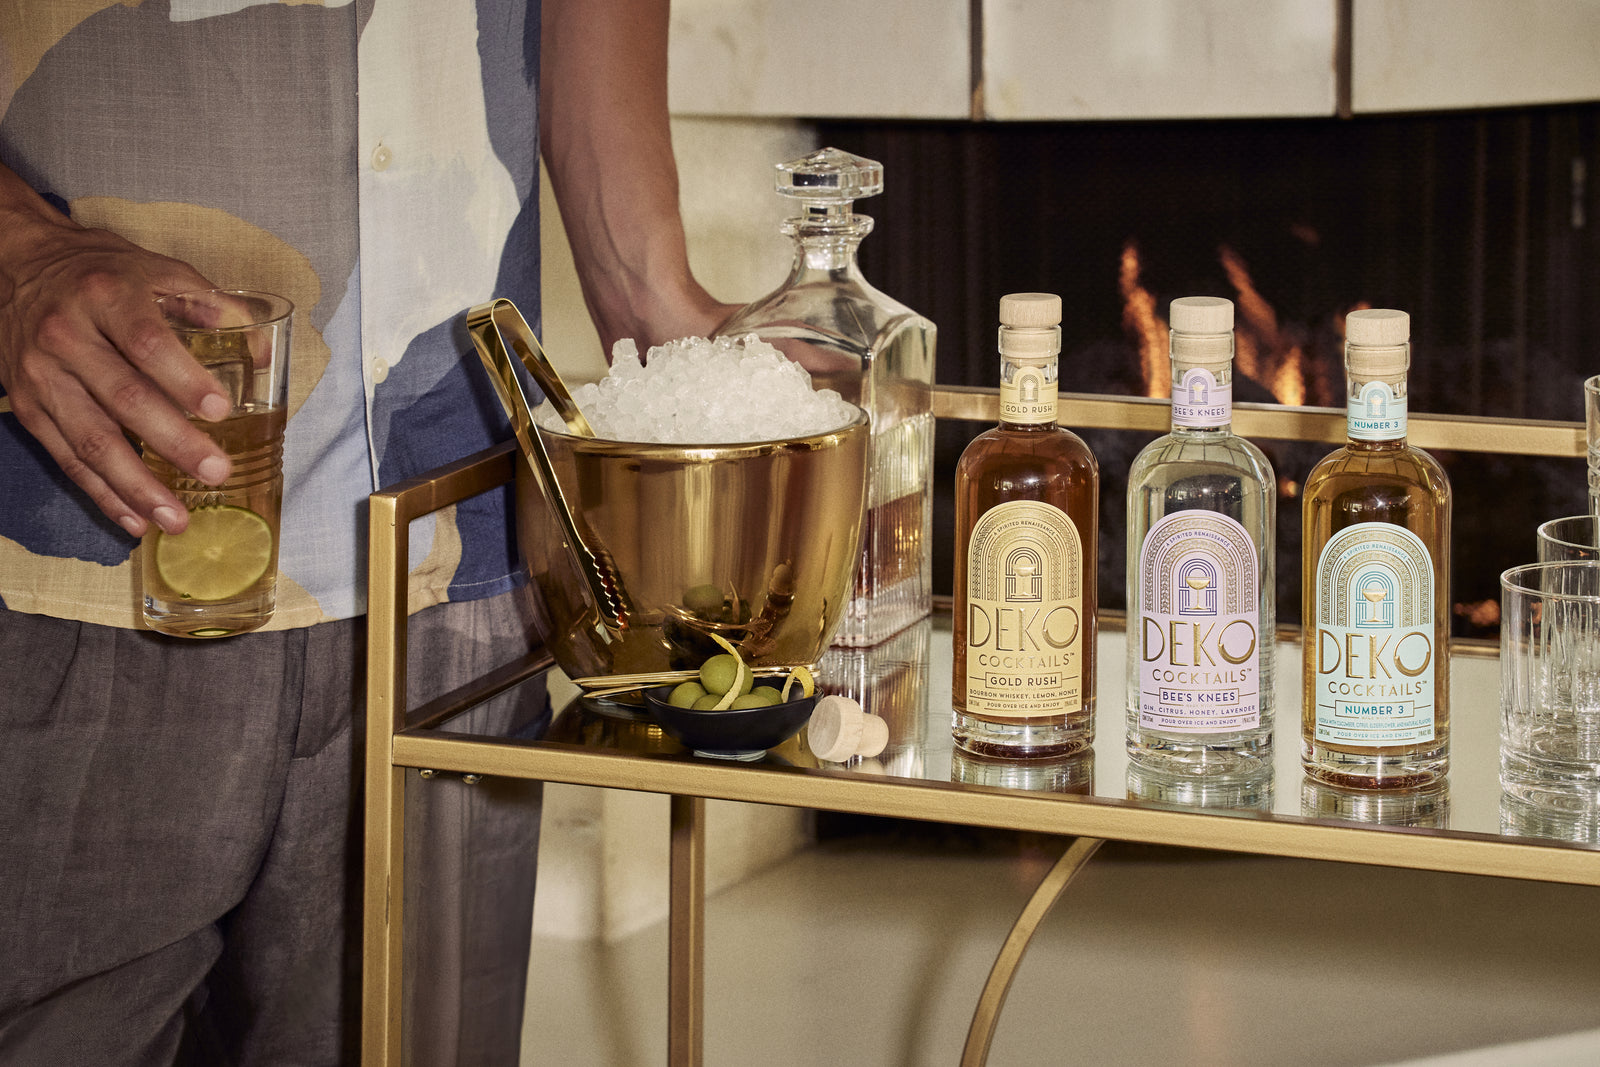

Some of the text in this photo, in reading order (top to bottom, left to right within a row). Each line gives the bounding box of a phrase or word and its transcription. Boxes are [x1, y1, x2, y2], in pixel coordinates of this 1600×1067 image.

[1005, 404, 1028, 414] GOLD
[1174, 406, 1225, 416] BEE'S KNEES
[1354, 421, 1390, 429] NUMBER
[997, 521, 1020, 532] SPIRITED
[1020, 520, 1056, 536] RENAISSANCE
[1170, 532, 1192, 544] SPIRITED
[1194, 531, 1230, 547] RENAISSANCE
[970, 603, 1079, 651] DEKO
[1143, 616, 1256, 667] DEKO
[1318, 628, 1432, 680] DEKO
[990, 676, 1057, 686] GOLD RUSH
[970, 688, 998, 698] BOURBON
[1162, 692, 1236, 702] BEE'S KNEES
[1221, 705, 1256, 714] LAVENDER
[1345, 706, 1404, 714] NUMBER 3
